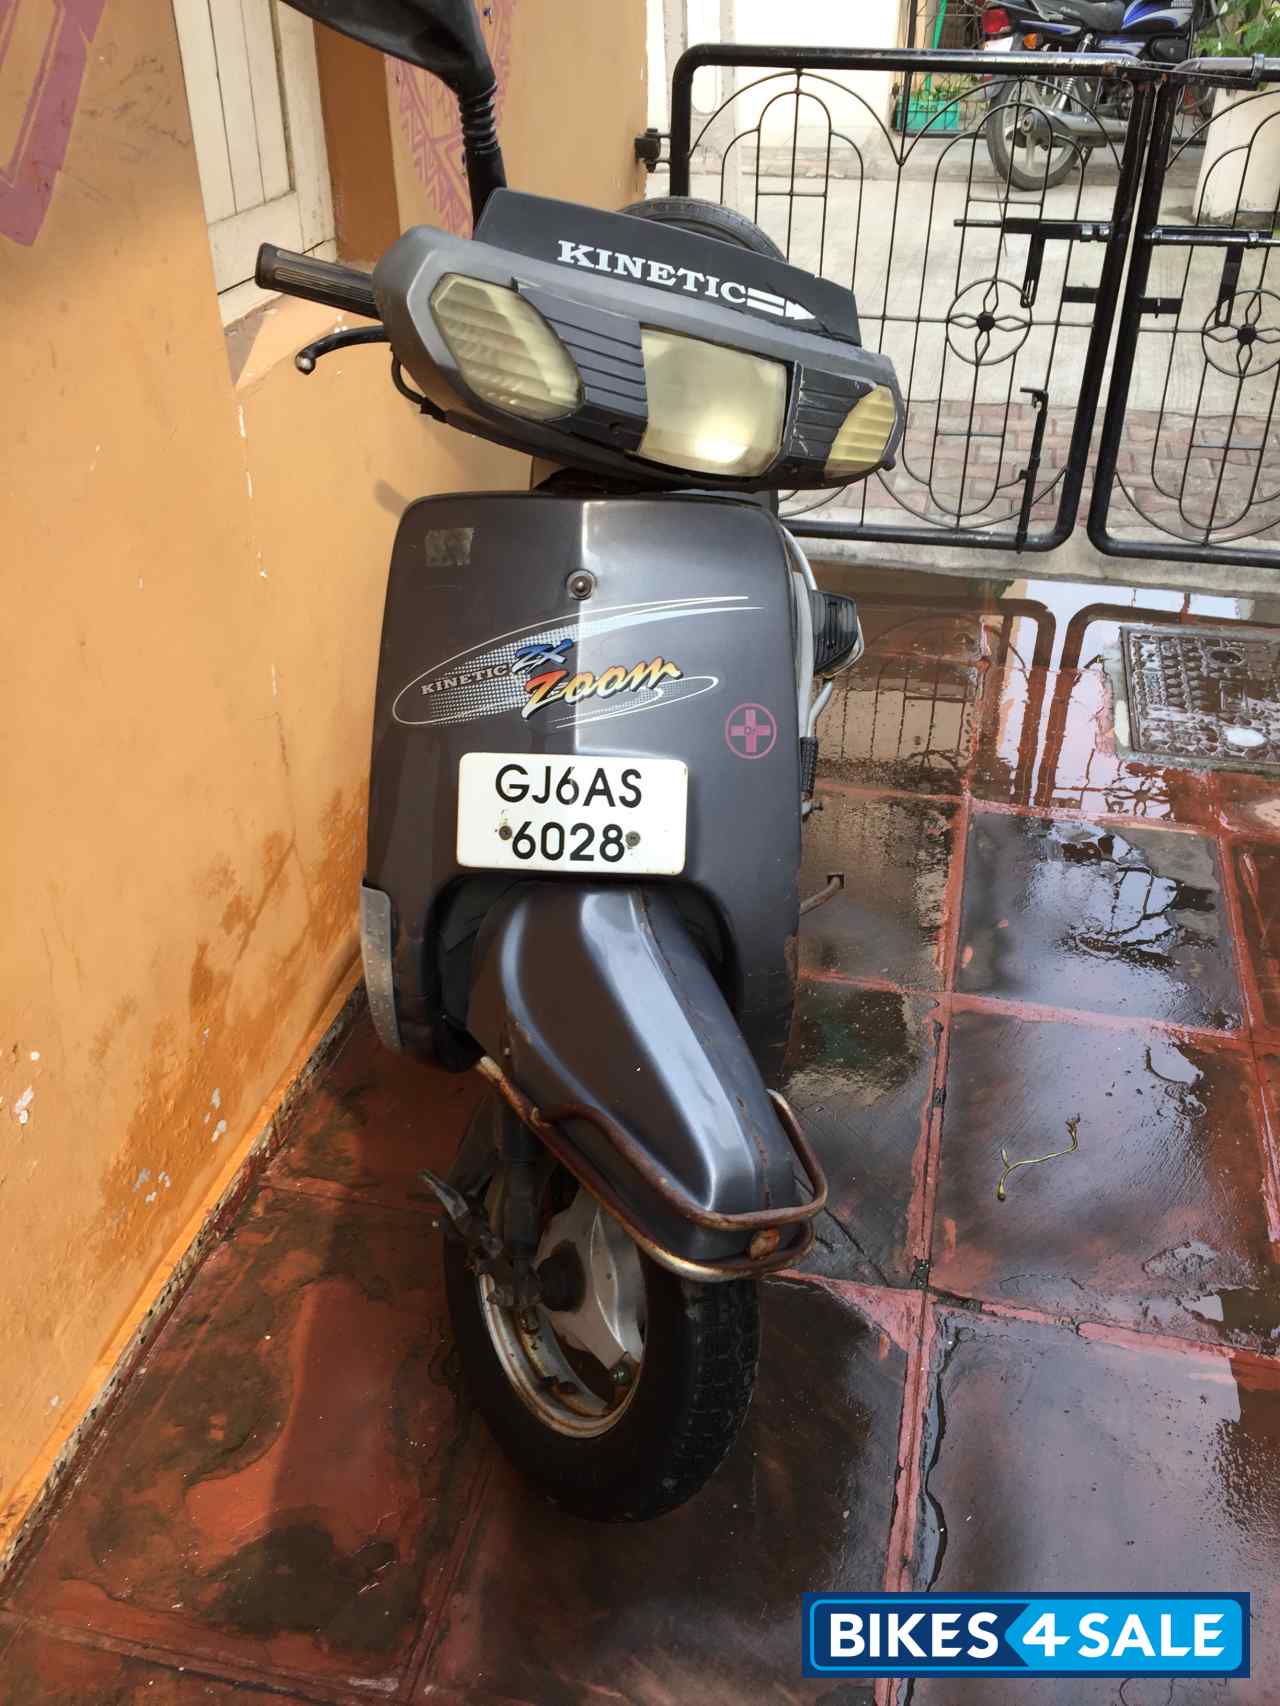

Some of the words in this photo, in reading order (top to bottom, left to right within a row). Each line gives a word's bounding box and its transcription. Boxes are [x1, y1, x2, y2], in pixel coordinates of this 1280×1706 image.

[557, 240, 746, 304] KINETIC
[421, 664, 509, 696] KINETIC
[521, 656, 683, 720] Zoom
[494, 763, 642, 809] GJ6AS
[511, 820, 626, 863] 6028
